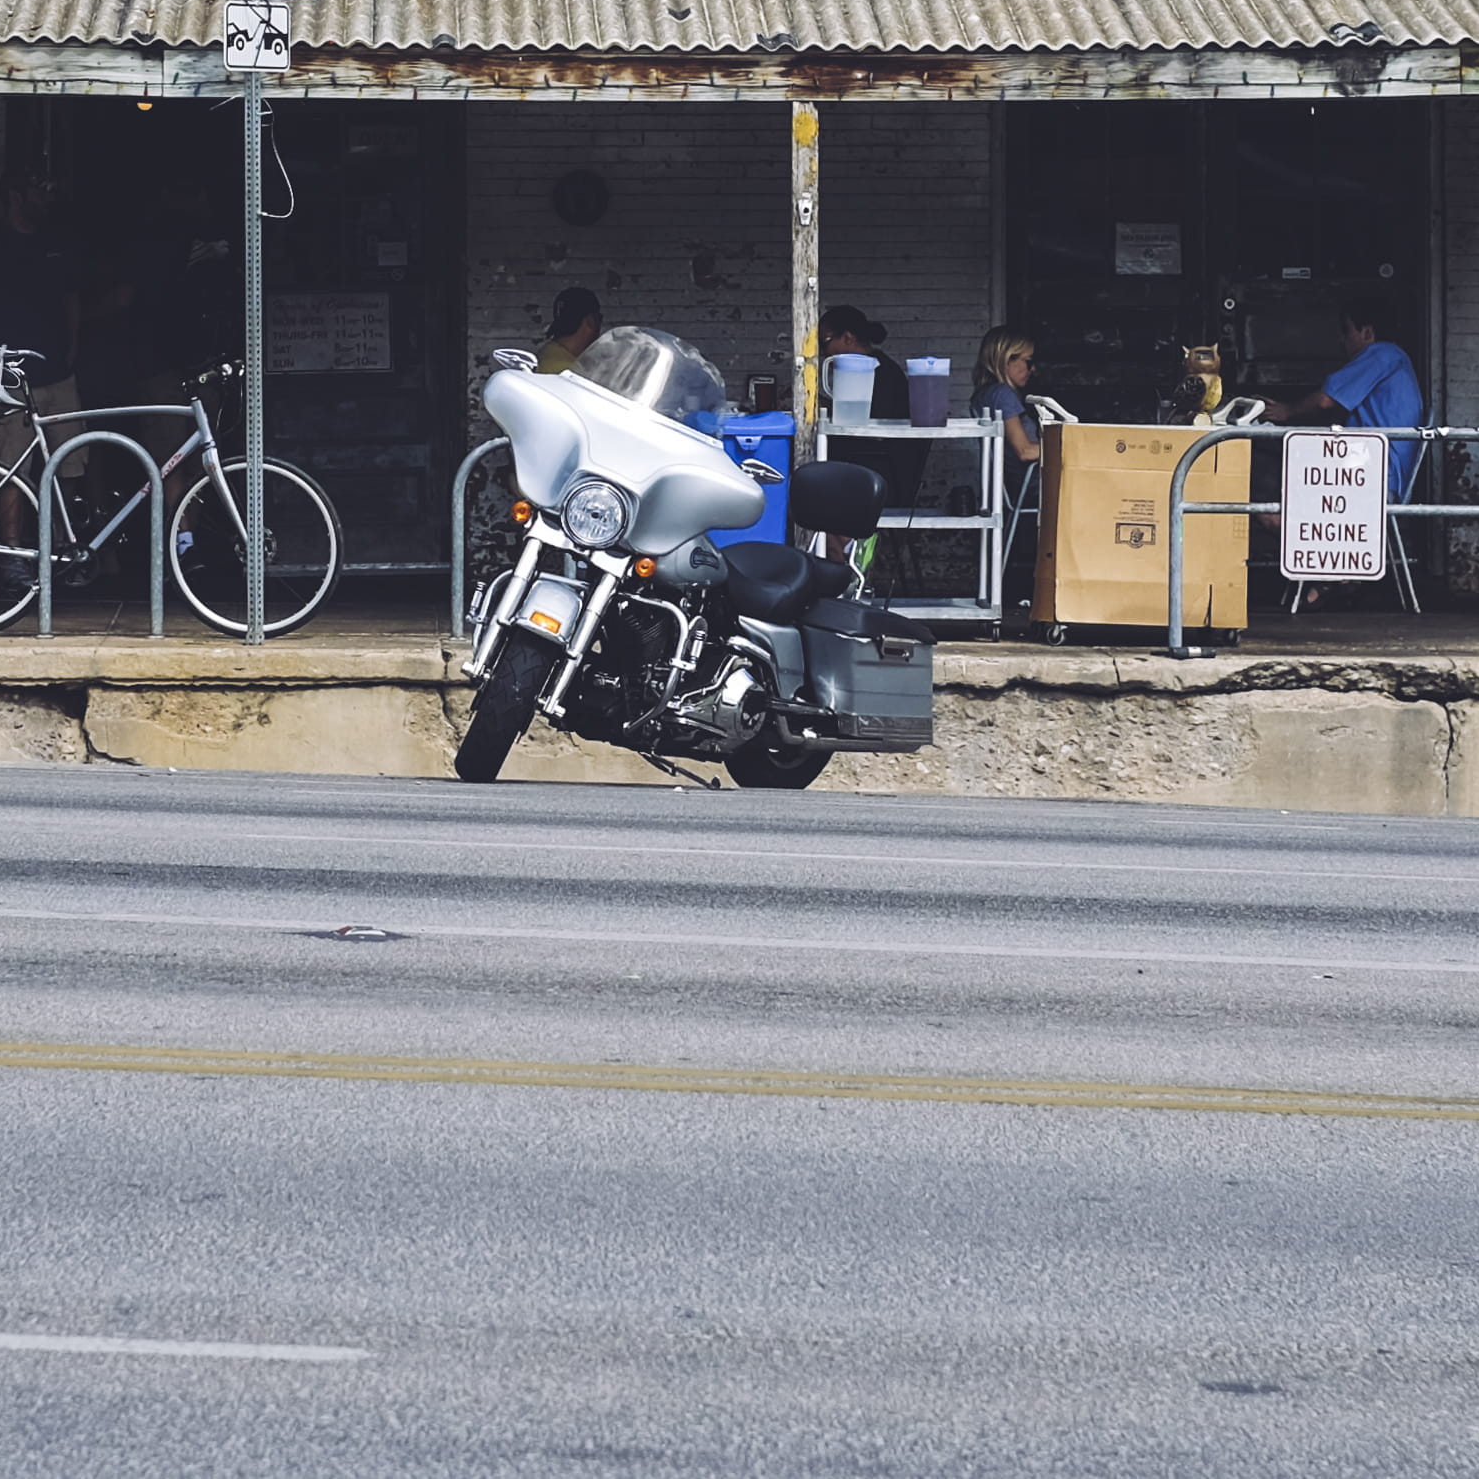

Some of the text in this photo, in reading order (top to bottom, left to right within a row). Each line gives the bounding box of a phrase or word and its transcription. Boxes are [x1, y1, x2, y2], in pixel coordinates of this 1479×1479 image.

[1323, 439, 1348, 459] NO
[1304, 467, 1366, 487] IDLING
[1321, 495, 1347, 514] NO
[1299, 523, 1368, 542] ENGINE
[1293, 550, 1373, 571] REVVING
